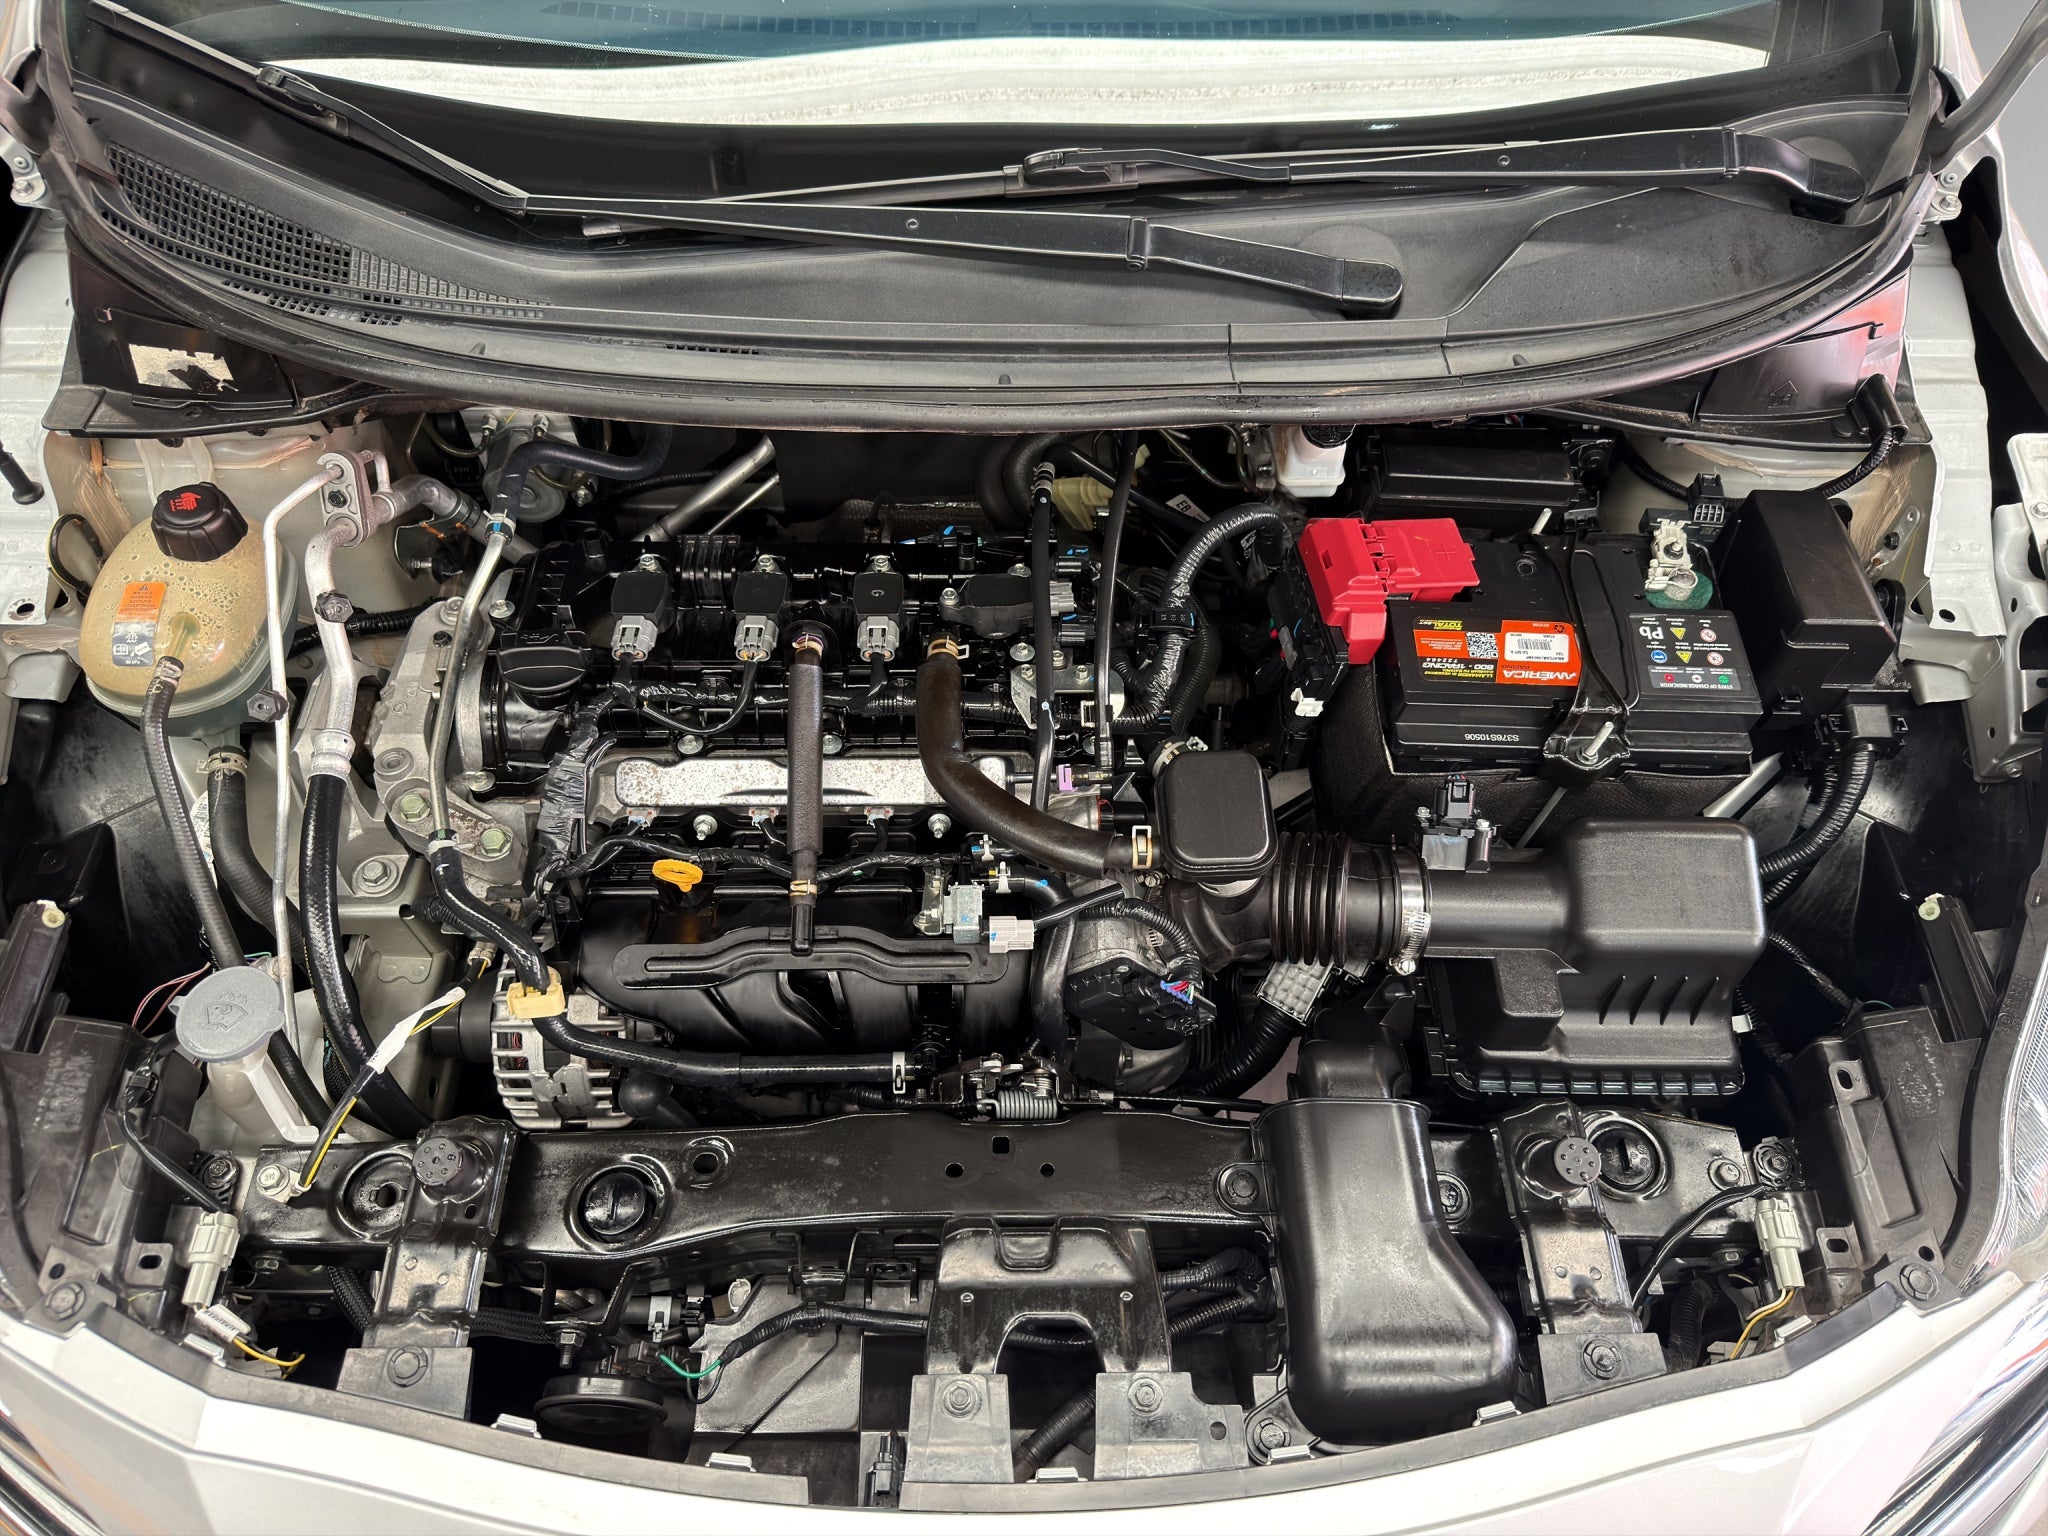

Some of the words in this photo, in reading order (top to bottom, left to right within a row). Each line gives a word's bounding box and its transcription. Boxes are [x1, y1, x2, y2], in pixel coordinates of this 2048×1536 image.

[1176, 500, 1192, 512] EB
[1639, 626, 1664, 640] Pb
[1503, 670, 1577, 681] AMÉRICA
